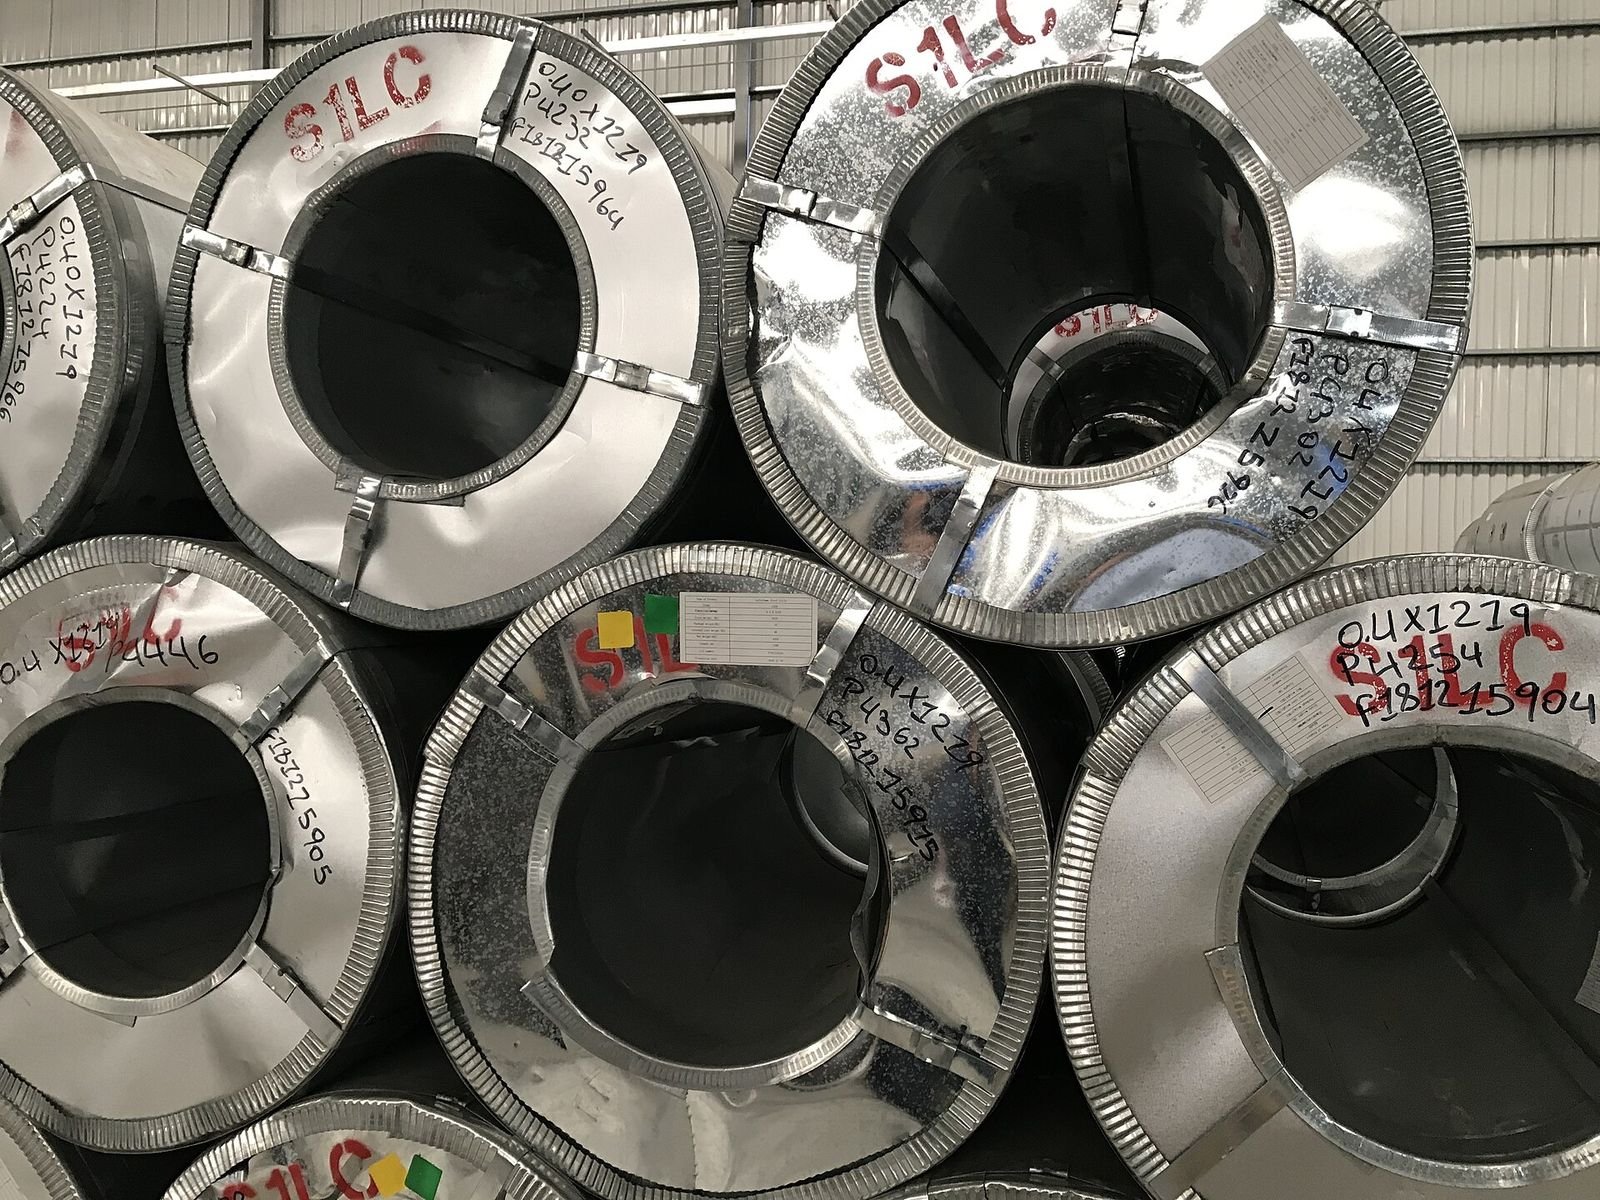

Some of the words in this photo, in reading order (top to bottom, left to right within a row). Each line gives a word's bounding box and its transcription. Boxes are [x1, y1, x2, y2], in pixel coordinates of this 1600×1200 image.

[285, 45, 432, 162] S1LC
[523, 82, 590, 149] P4232
[32, 226, 56, 339] P4224
[1330, 623, 1567, 716] S1LC
[1337, 642, 1484, 686] P4254
[842, 677, 919, 759] P4362
